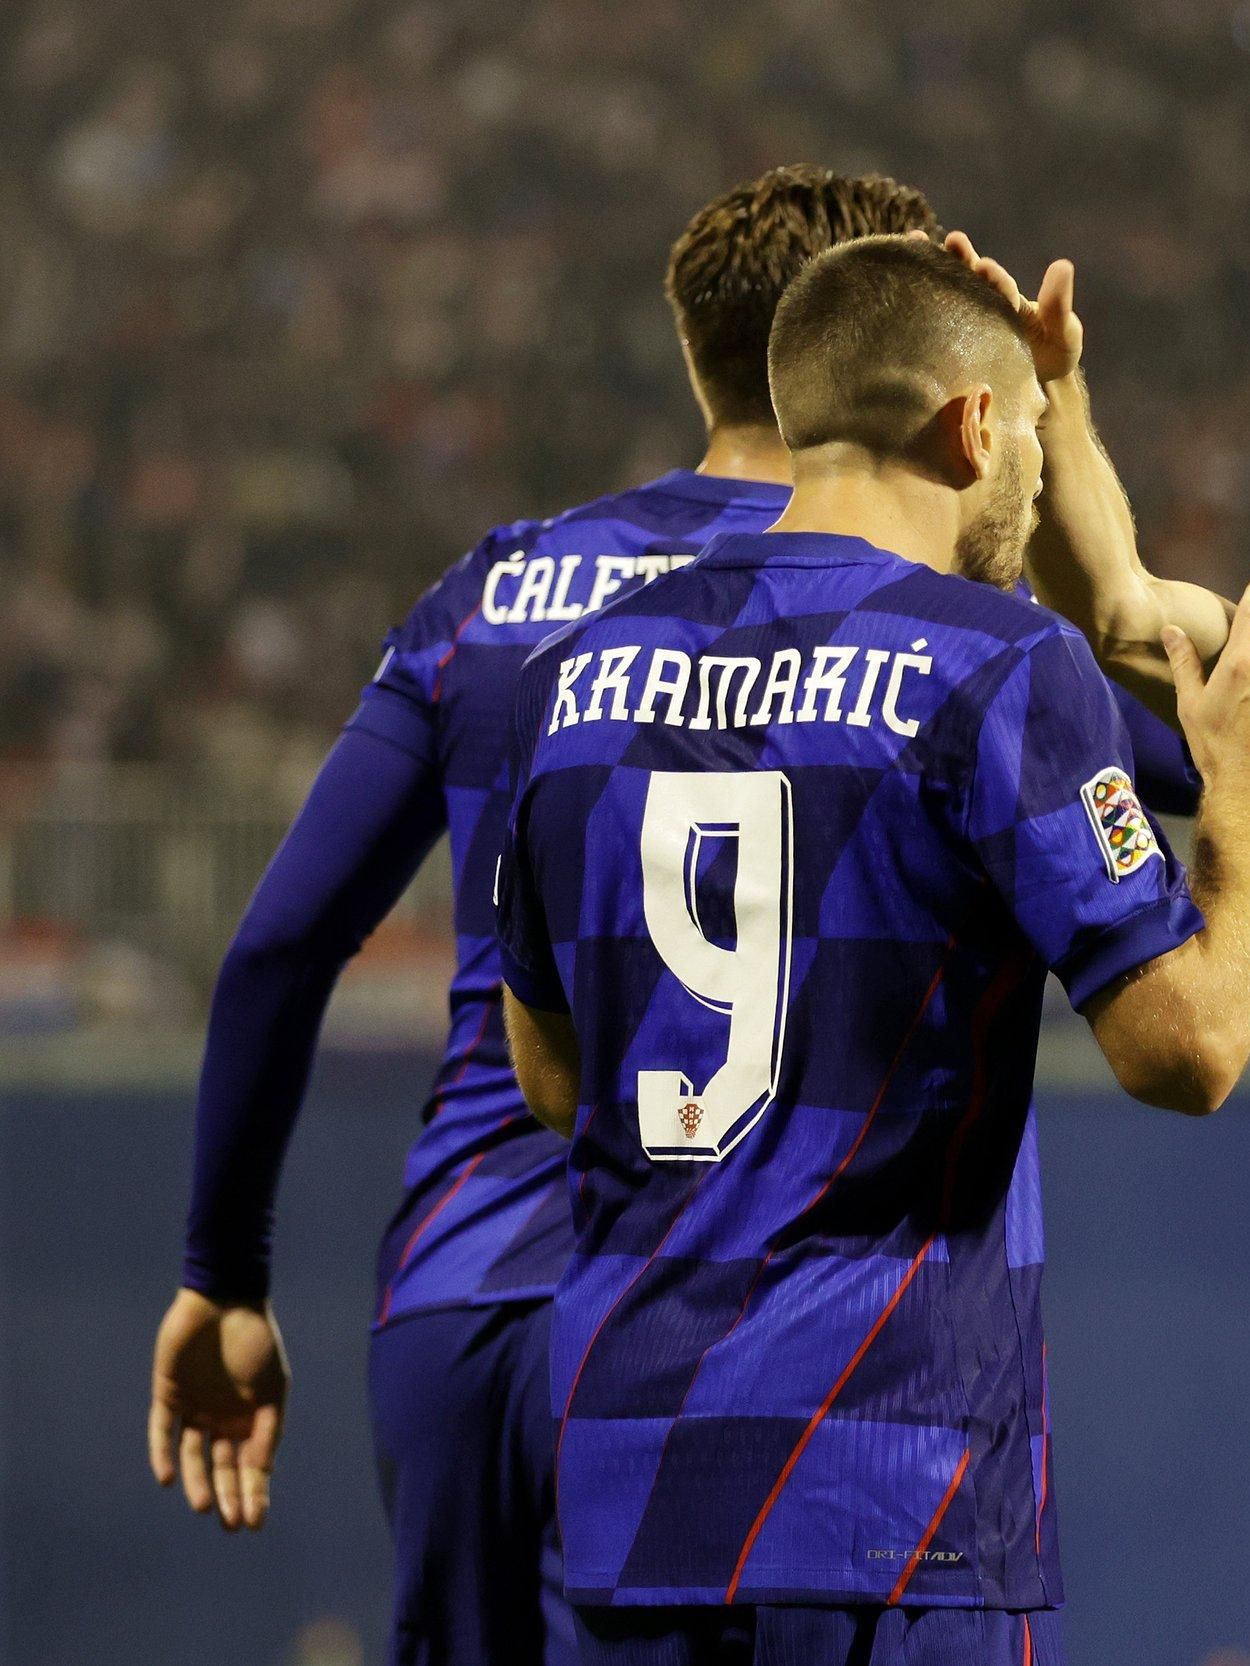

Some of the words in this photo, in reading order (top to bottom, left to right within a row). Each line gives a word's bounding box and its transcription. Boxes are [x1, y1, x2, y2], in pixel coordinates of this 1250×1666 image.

[482, 550, 697, 625] ĆALET
[547, 638, 933, 738] KRAMARIĆ
[637, 770, 794, 1161] 9
